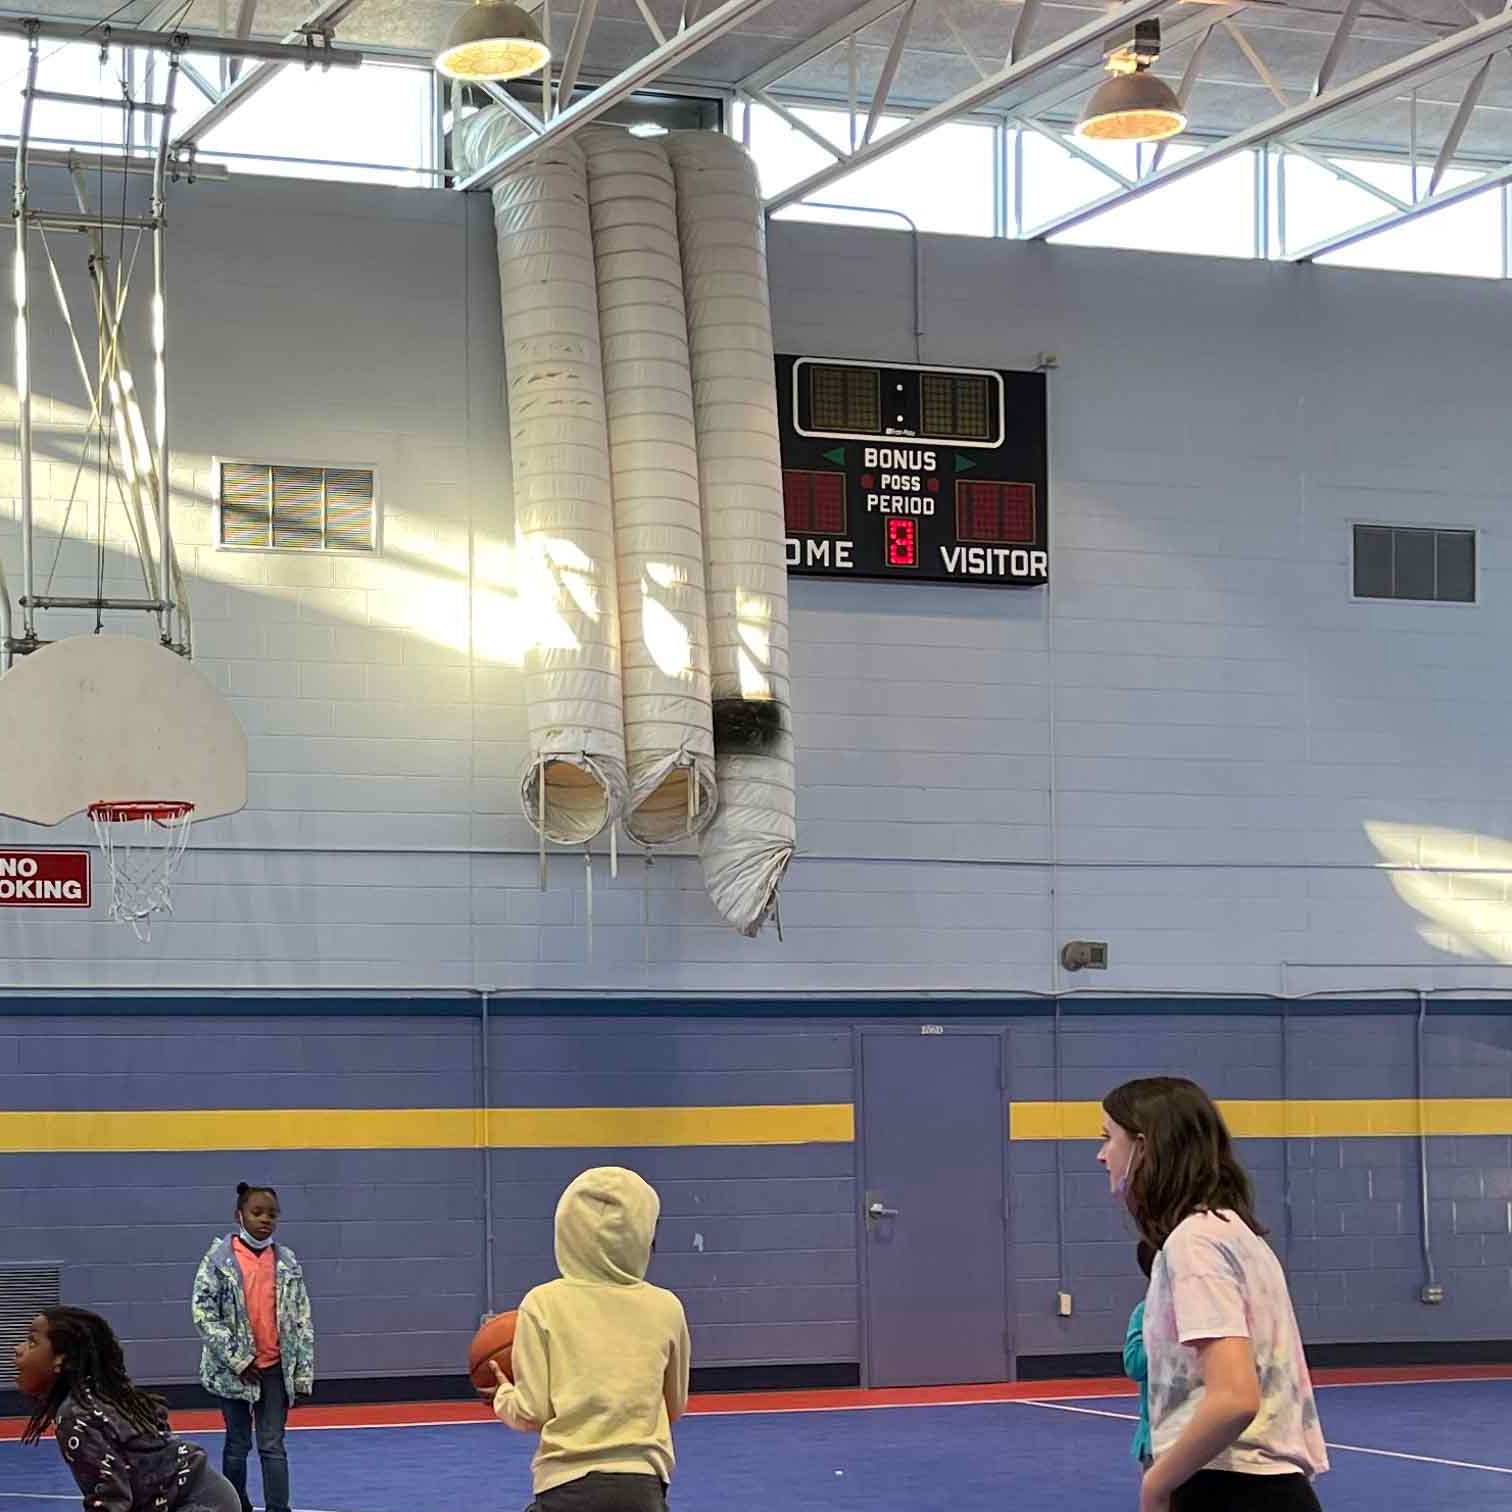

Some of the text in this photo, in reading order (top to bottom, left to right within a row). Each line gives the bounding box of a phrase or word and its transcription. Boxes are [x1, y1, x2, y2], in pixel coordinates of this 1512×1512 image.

[864, 448, 937, 471] BONUS
[881, 474, 921, 491] POSS
[867, 494, 935, 515] PERIOD
[785, 539, 854, 568] OME
[889, 519, 915, 565] 8
[940, 546, 1048, 577] VISITOR
